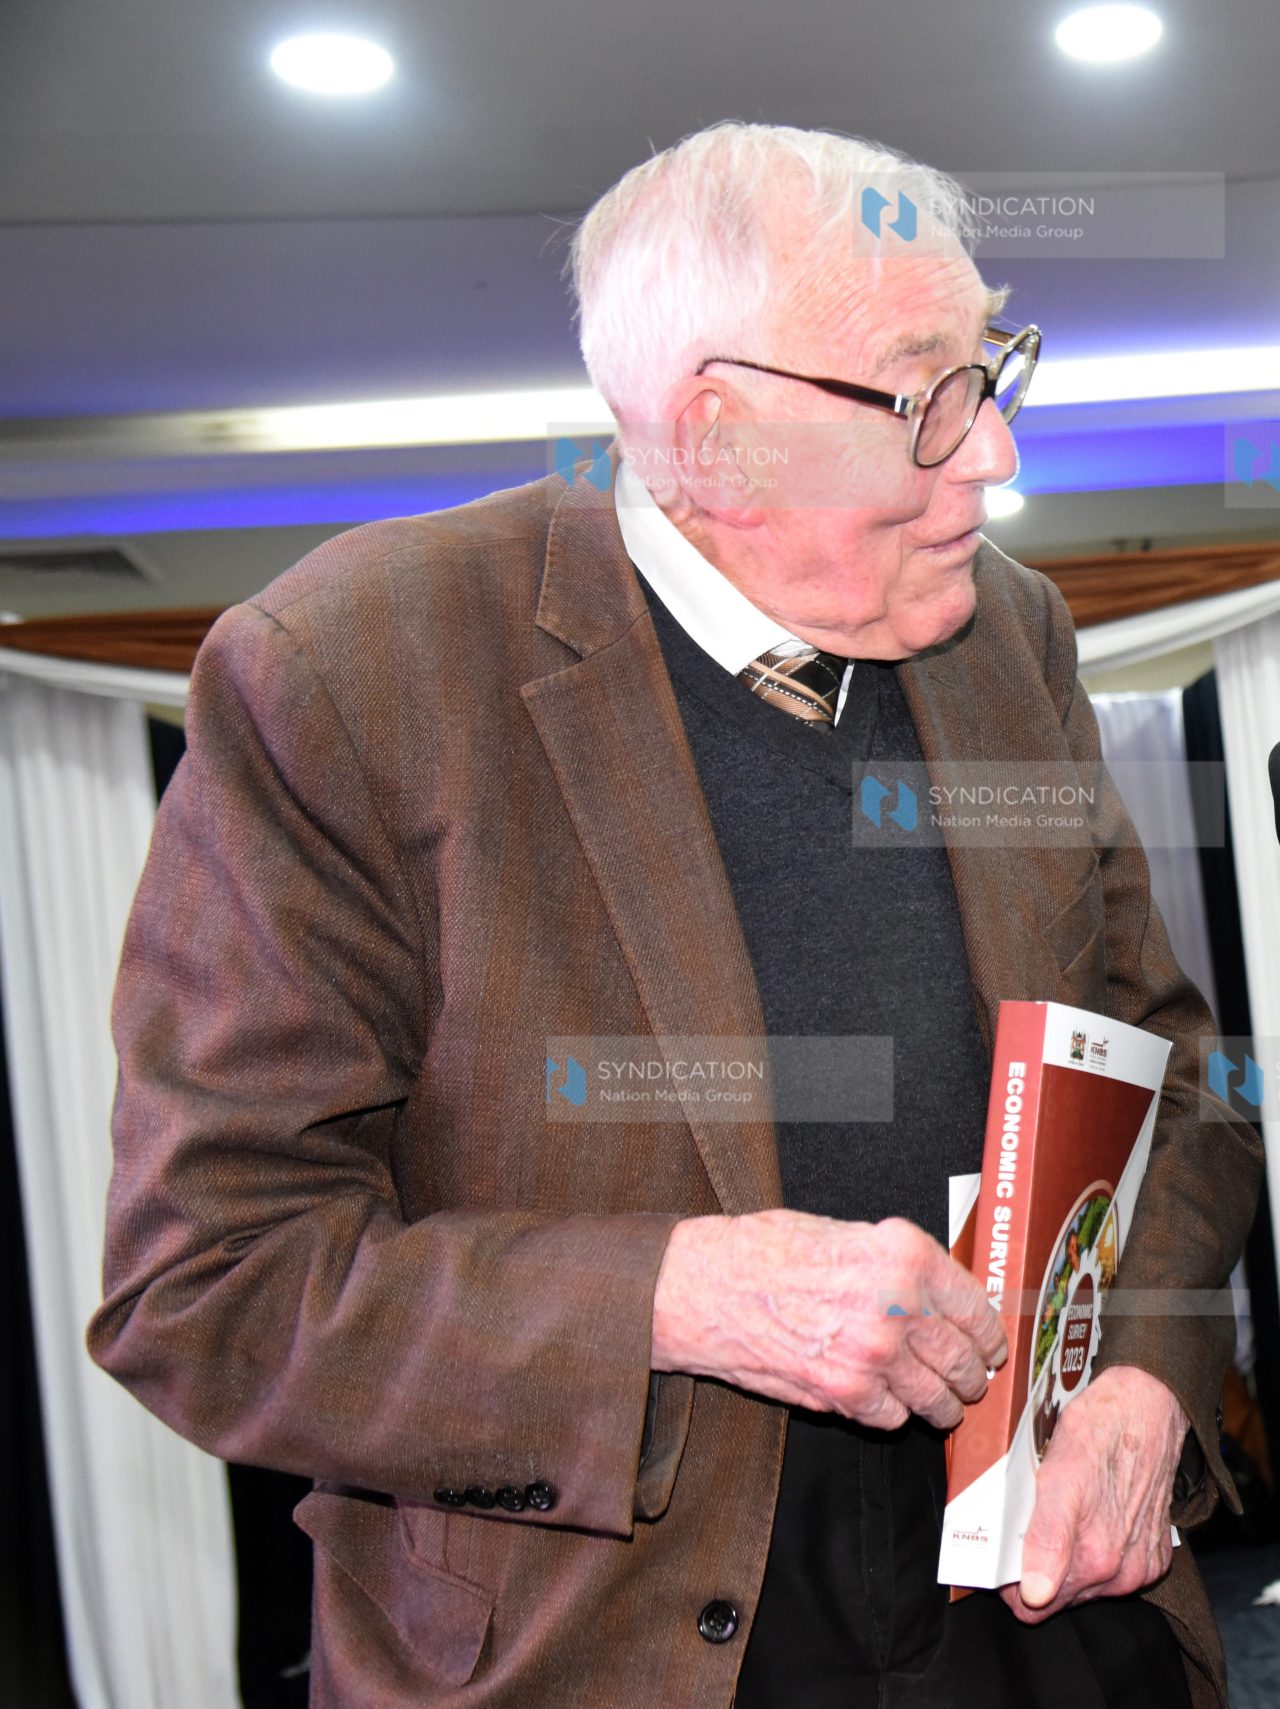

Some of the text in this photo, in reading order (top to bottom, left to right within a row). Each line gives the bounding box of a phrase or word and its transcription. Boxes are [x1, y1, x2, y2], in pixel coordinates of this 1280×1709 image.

[986, 1062, 1026, 1312] ECONOMIC SURVEY
[1068, 1304, 1092, 1320] ECONOMIC
[1068, 1323, 1088, 1340] SURVEY
[1062, 1347, 1084, 1372] 2023
